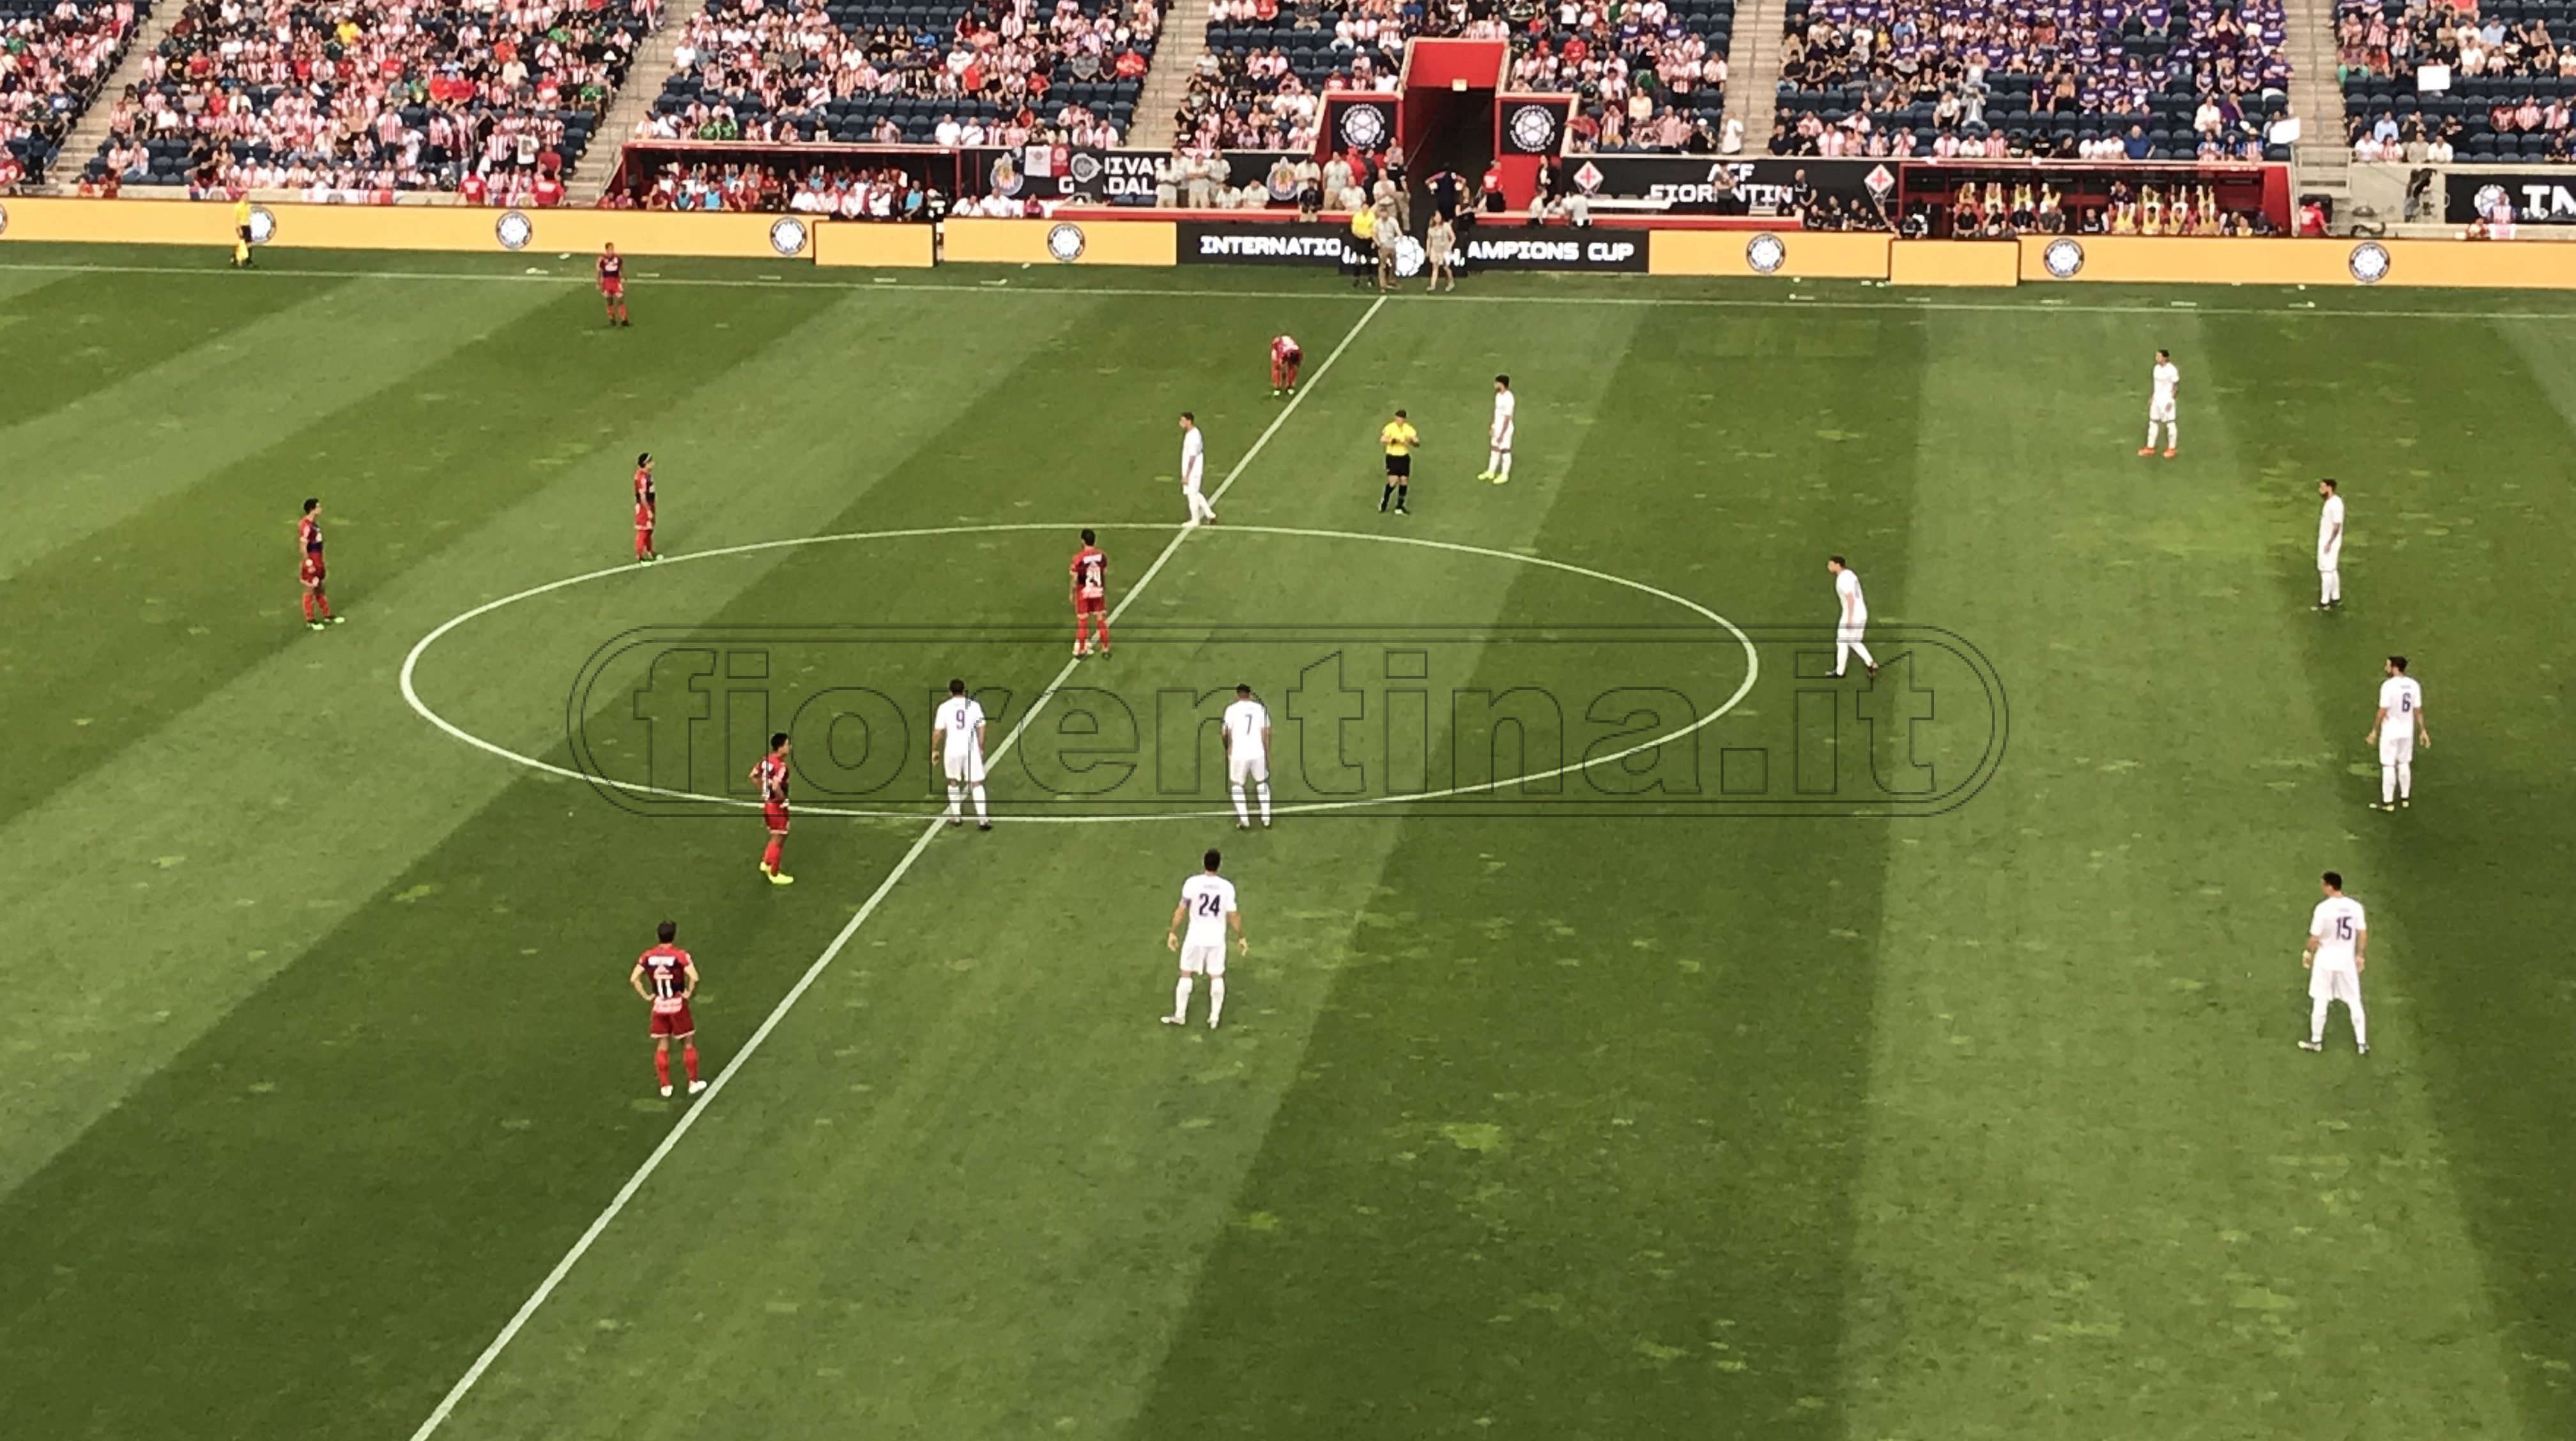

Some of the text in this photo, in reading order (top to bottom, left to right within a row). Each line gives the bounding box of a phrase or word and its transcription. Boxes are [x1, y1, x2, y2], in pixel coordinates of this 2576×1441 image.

[1588, 242, 1634, 261] CUP
[2402, 692, 2411, 713] 6
[956, 709, 965, 730] 9
[1245, 713, 1253, 736] 7
[1199, 893, 1221, 917] 24
[2336, 916, 2352, 940] 15
